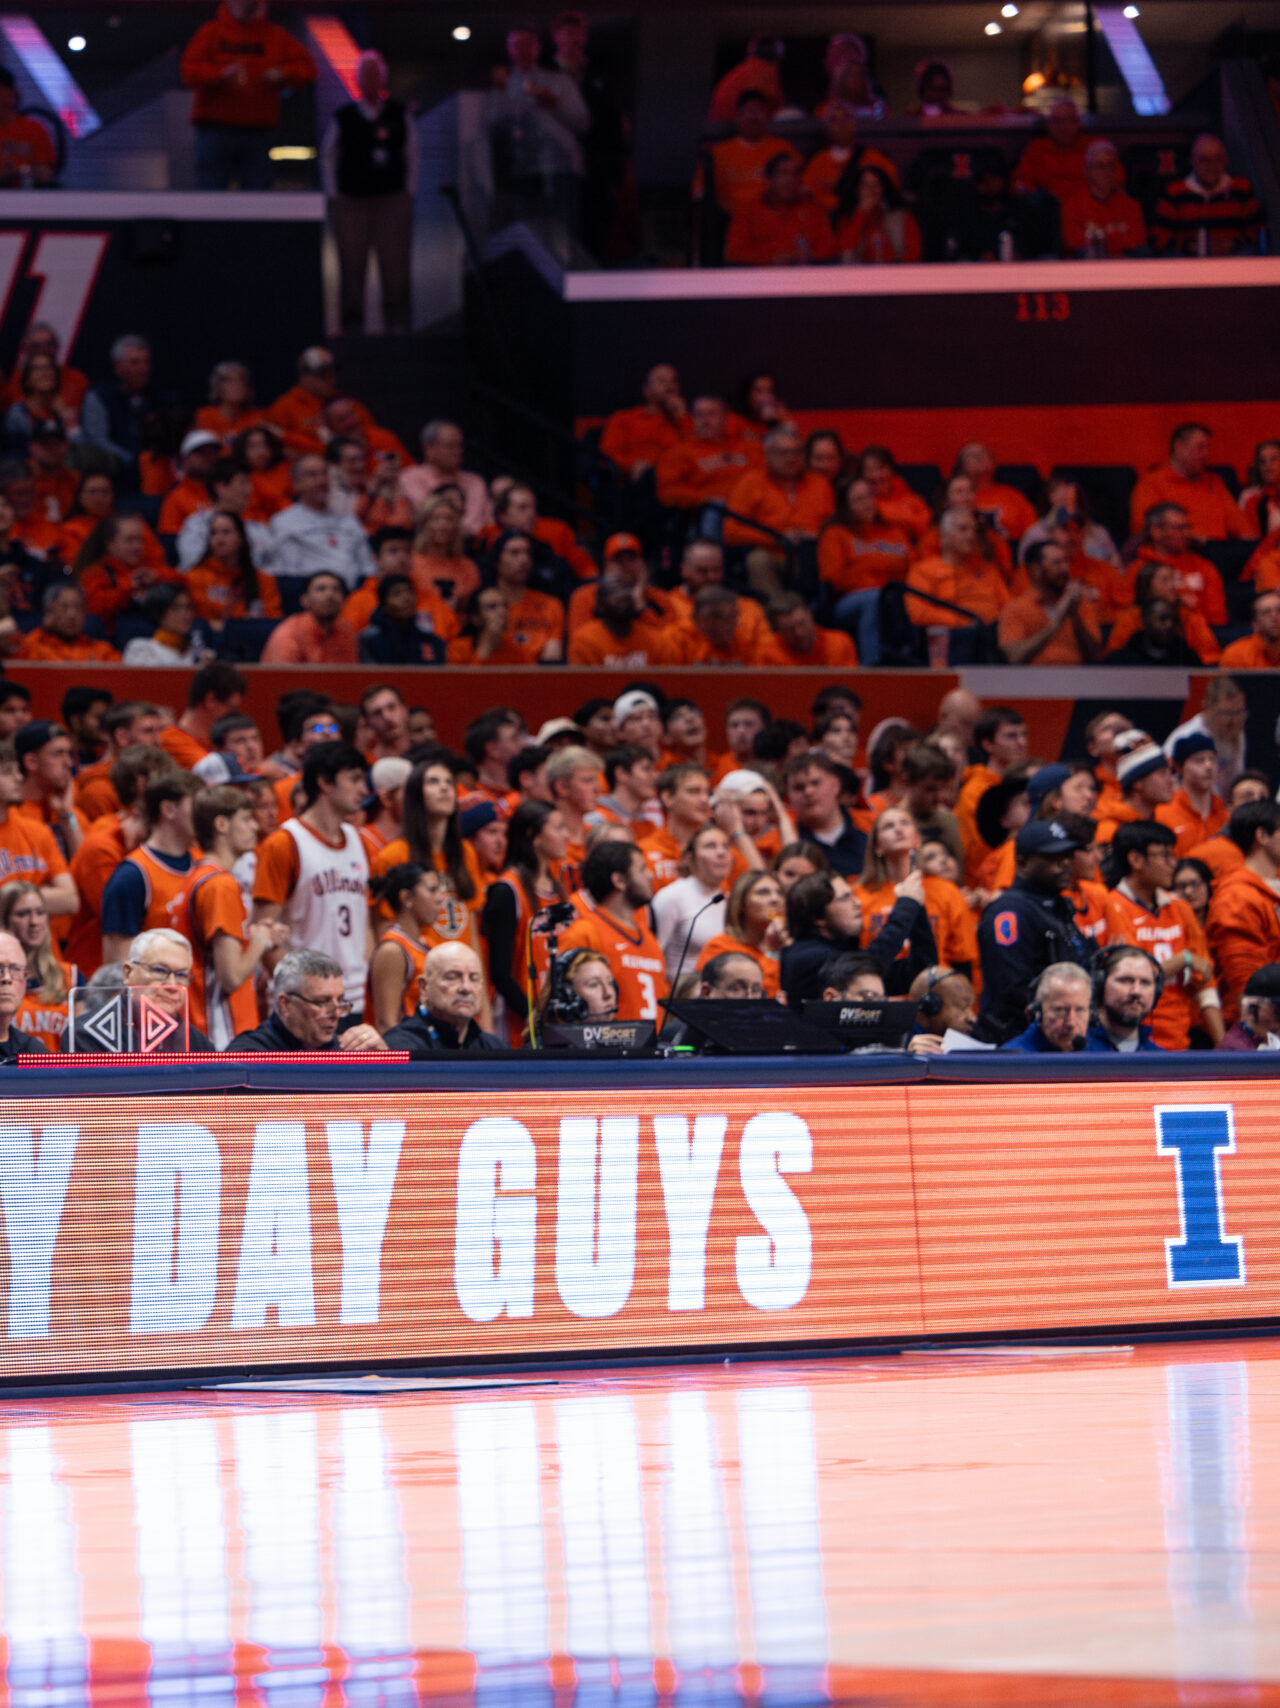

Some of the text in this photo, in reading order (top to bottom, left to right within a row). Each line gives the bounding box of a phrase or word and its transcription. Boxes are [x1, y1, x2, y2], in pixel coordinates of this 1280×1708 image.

[1016, 293, 1070, 321] 113
[338, 905, 351, 936] 3
[637, 972, 656, 1020] 3
[12, 1010, 68, 1034] ANG
[1154, 1104, 1246, 1289] I
[128, 1121, 406, 1334] DAY
[453, 1112, 813, 1322] GUYS
